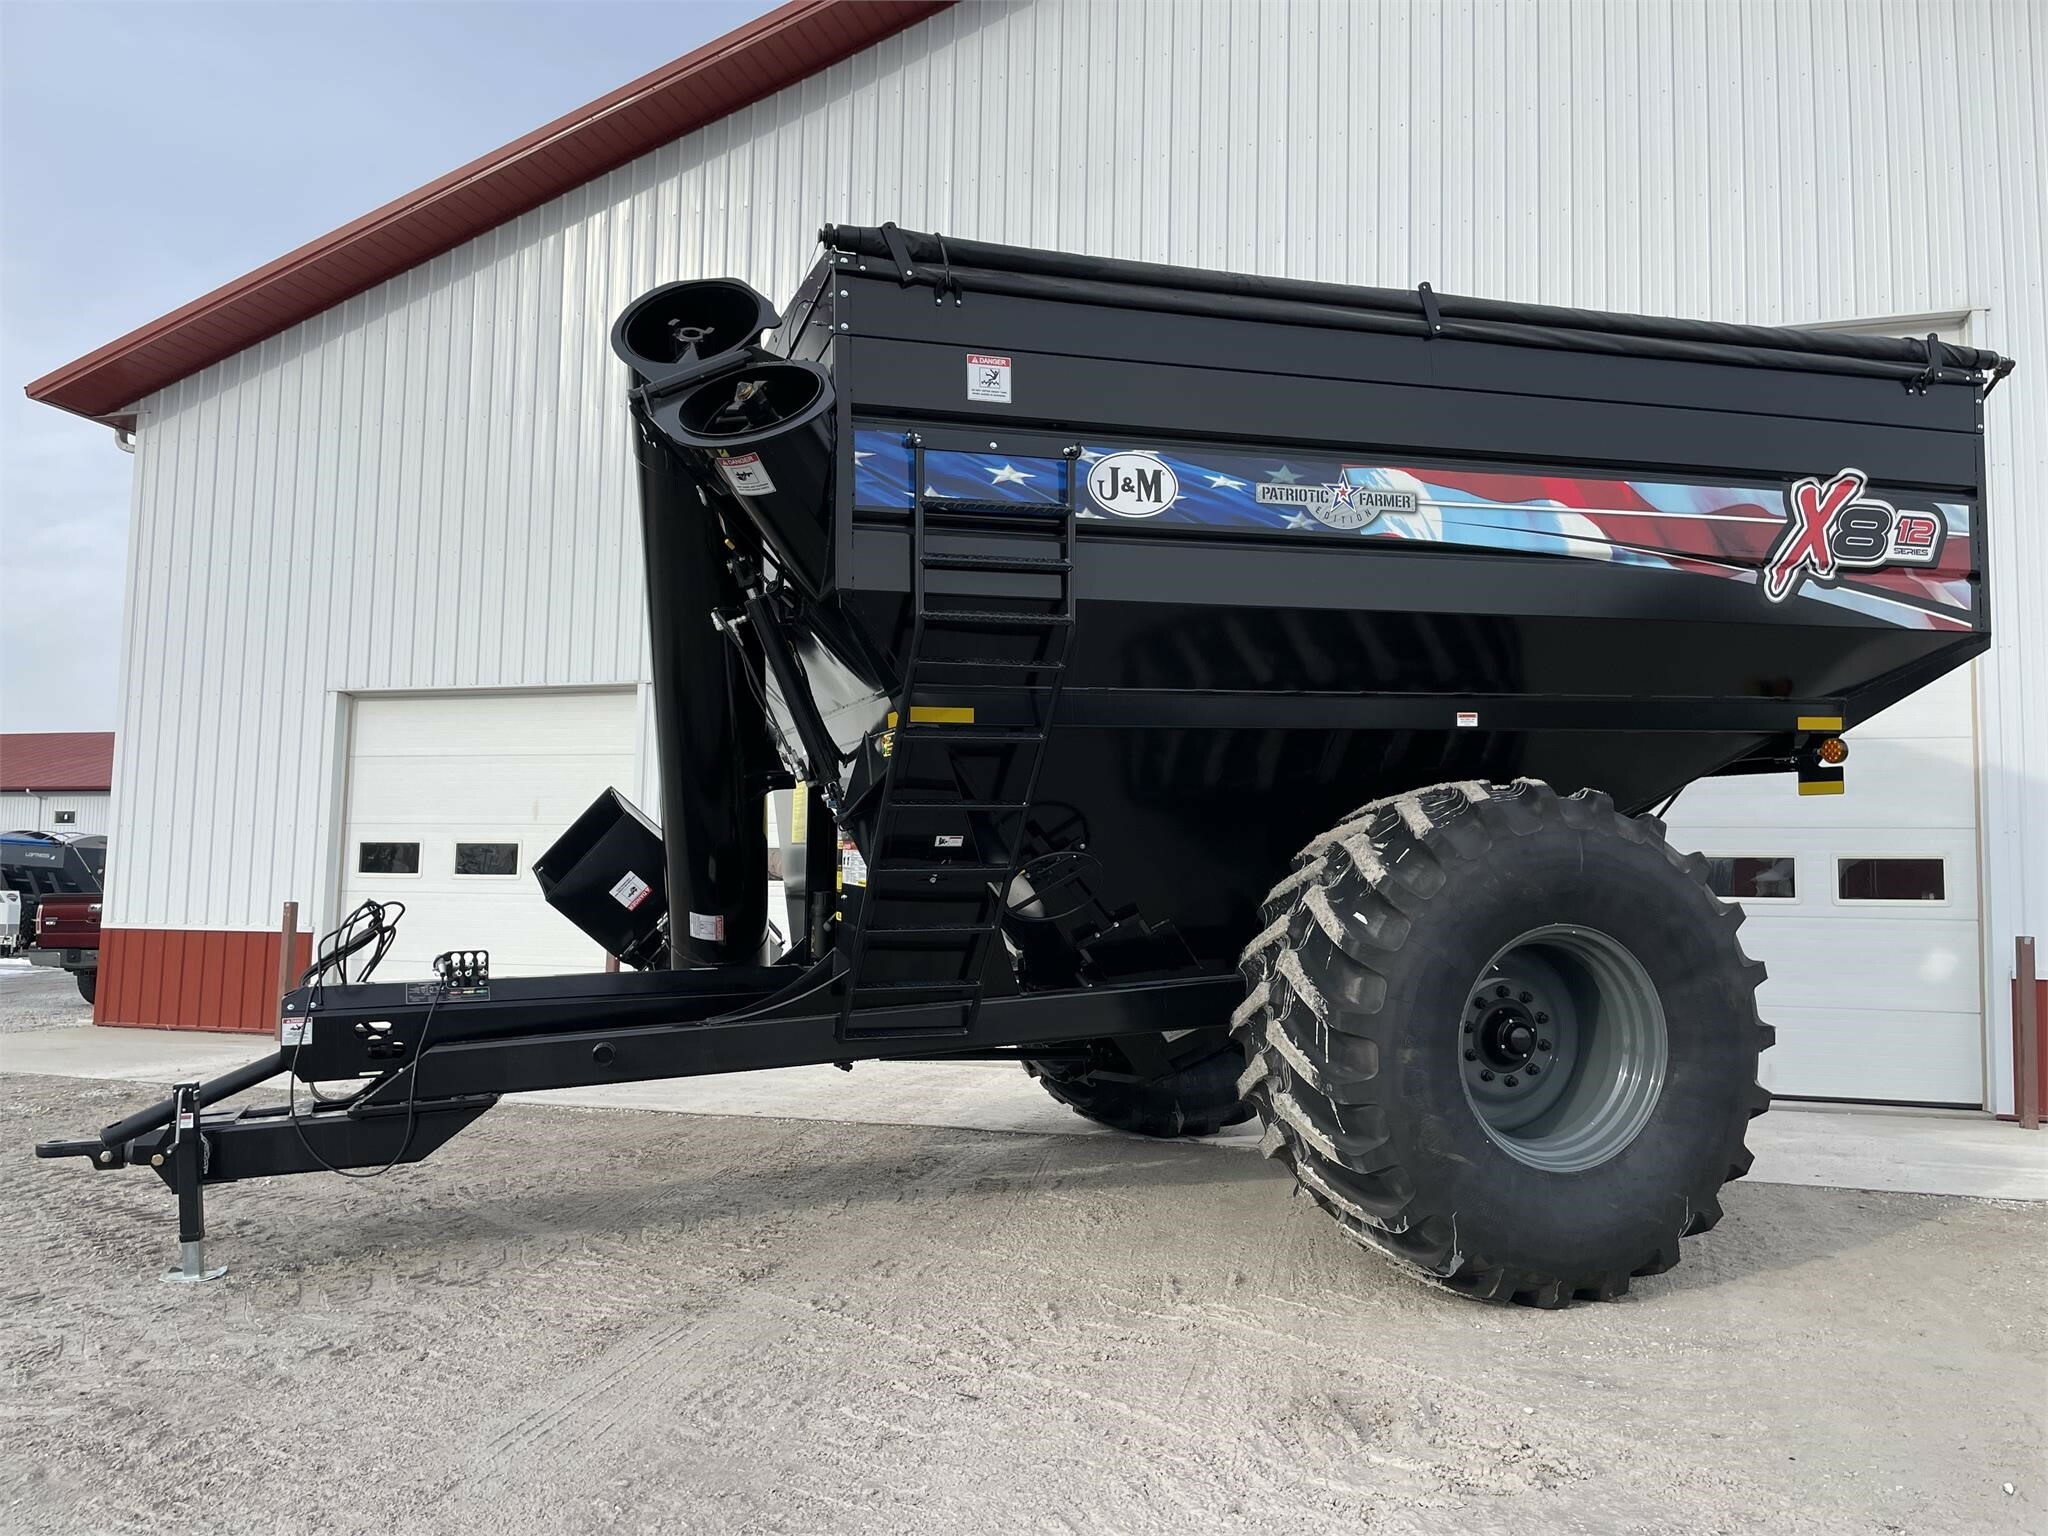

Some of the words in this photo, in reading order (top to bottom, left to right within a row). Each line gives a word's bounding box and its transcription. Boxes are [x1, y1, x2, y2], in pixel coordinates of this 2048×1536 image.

[980, 358, 1007, 366] DANGER
[728, 455, 754, 465] DANGER
[1097, 466, 1163, 503] J&M
[1261, 486, 1329, 503] PATRIOTIC
[1359, 493, 1411, 508] FARMER
[1315, 505, 1372, 524] EDITION
[1894, 547, 1928, 556] SERIES
